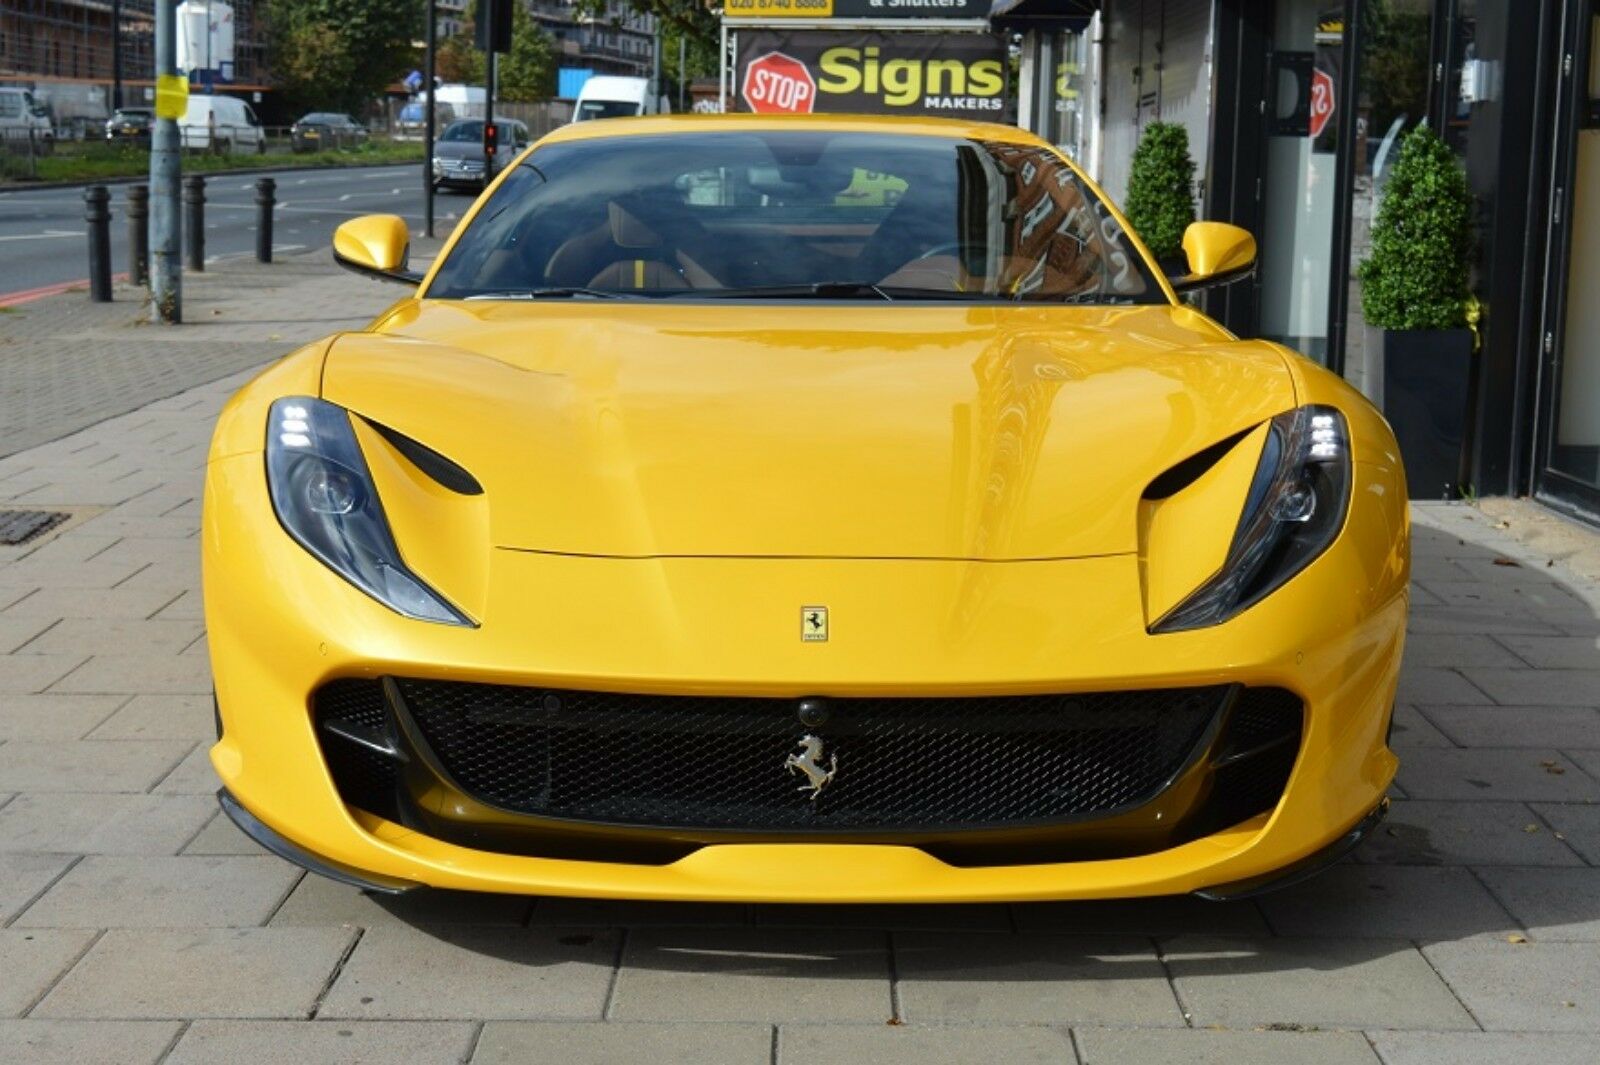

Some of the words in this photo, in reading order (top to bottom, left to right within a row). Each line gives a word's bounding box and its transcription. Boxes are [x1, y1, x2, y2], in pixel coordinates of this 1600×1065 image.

[751, 68, 810, 111] STOP
[818, 46, 1004, 106] Signs
[925, 96, 1002, 110] MAKERS
